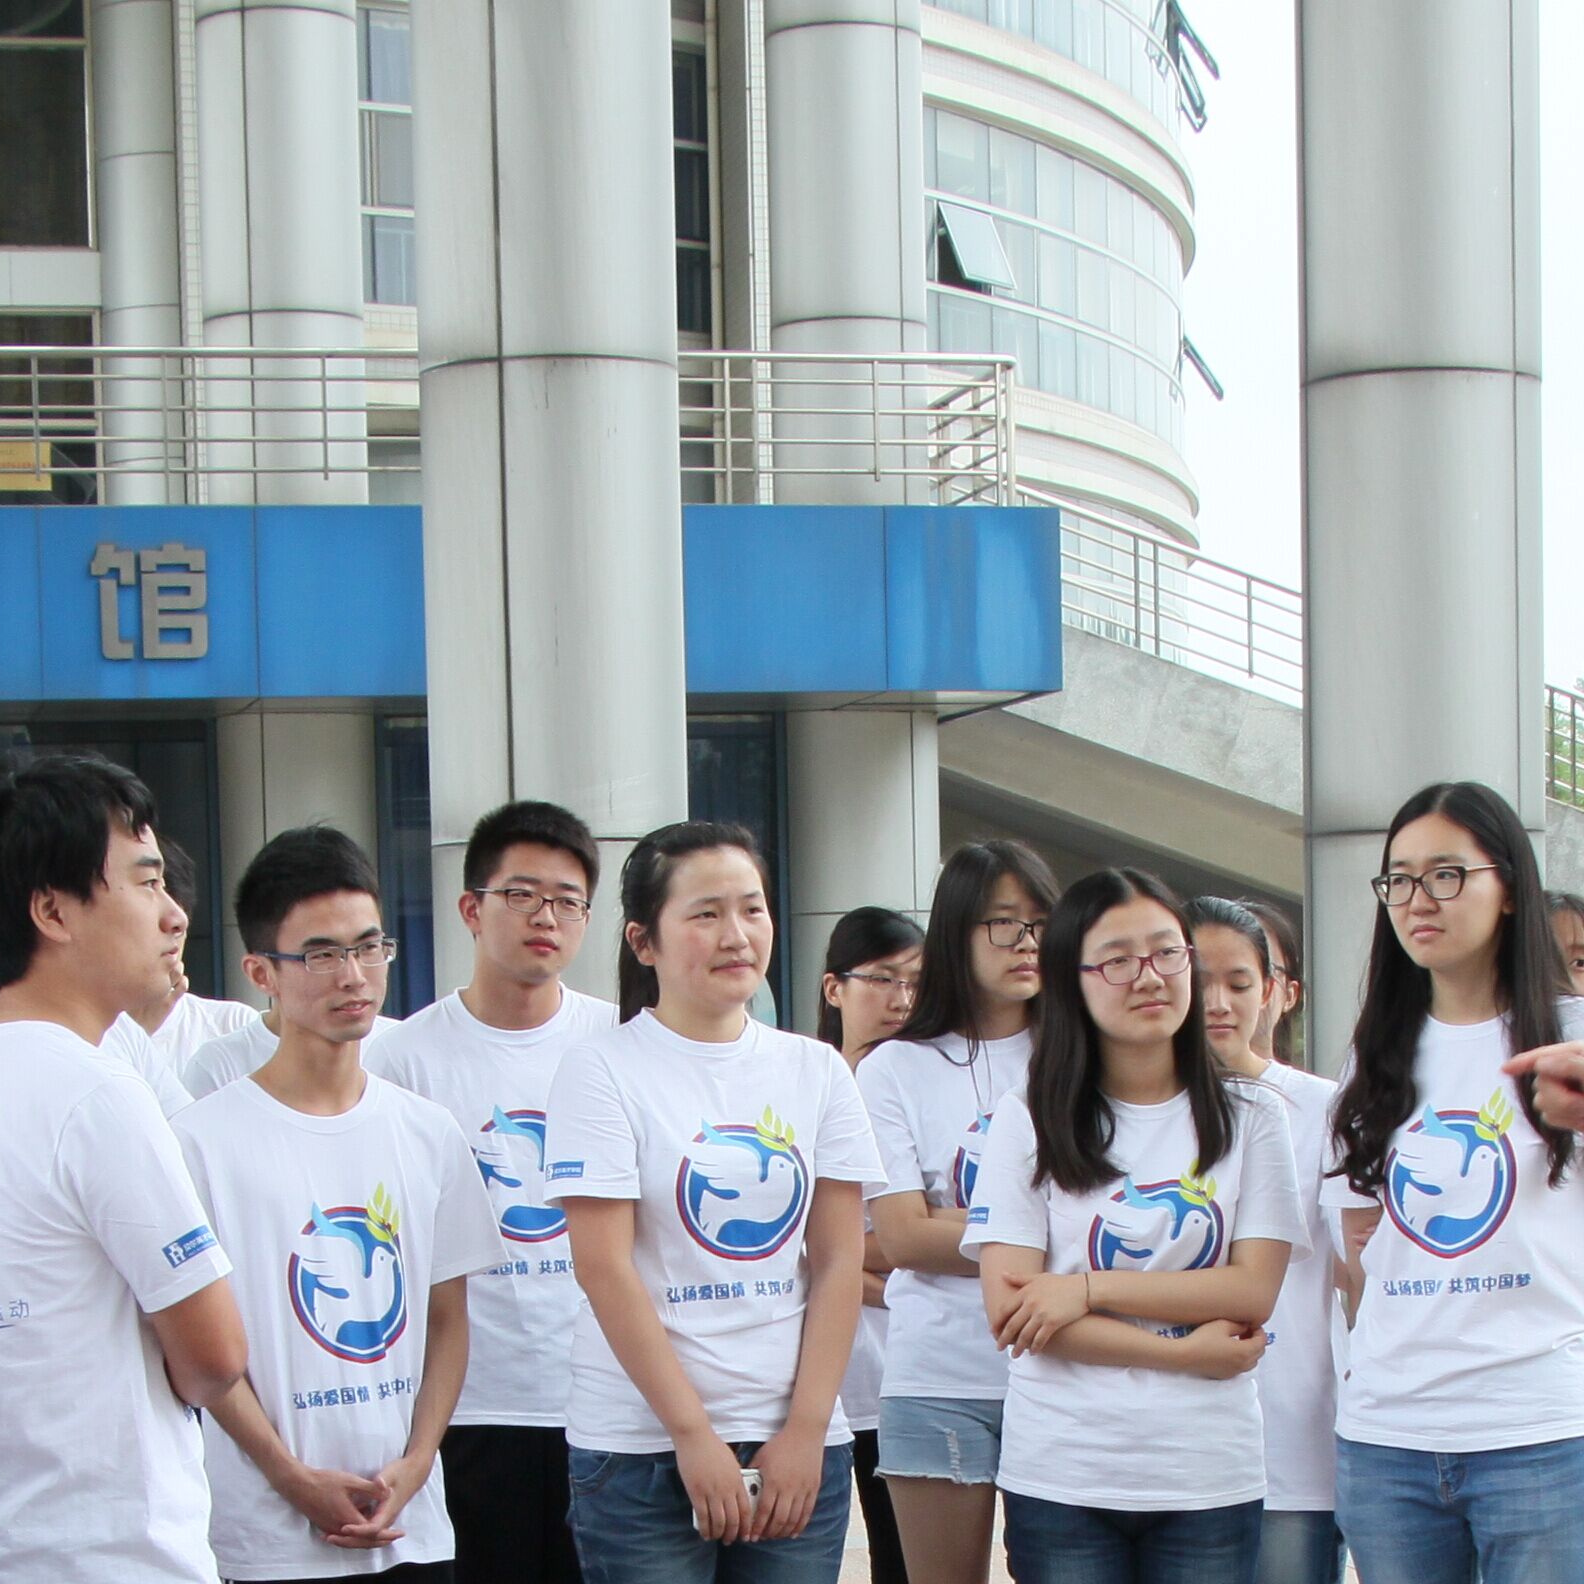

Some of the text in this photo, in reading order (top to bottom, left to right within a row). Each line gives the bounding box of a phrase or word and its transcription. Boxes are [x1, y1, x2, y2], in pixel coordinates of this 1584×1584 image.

[666, 1280, 746, 1304] 弘扬爱国情
[1447, 1272, 1532, 1295] 共筑中国梦
[292, 1385, 371, 1410] 弘扬爱国情
